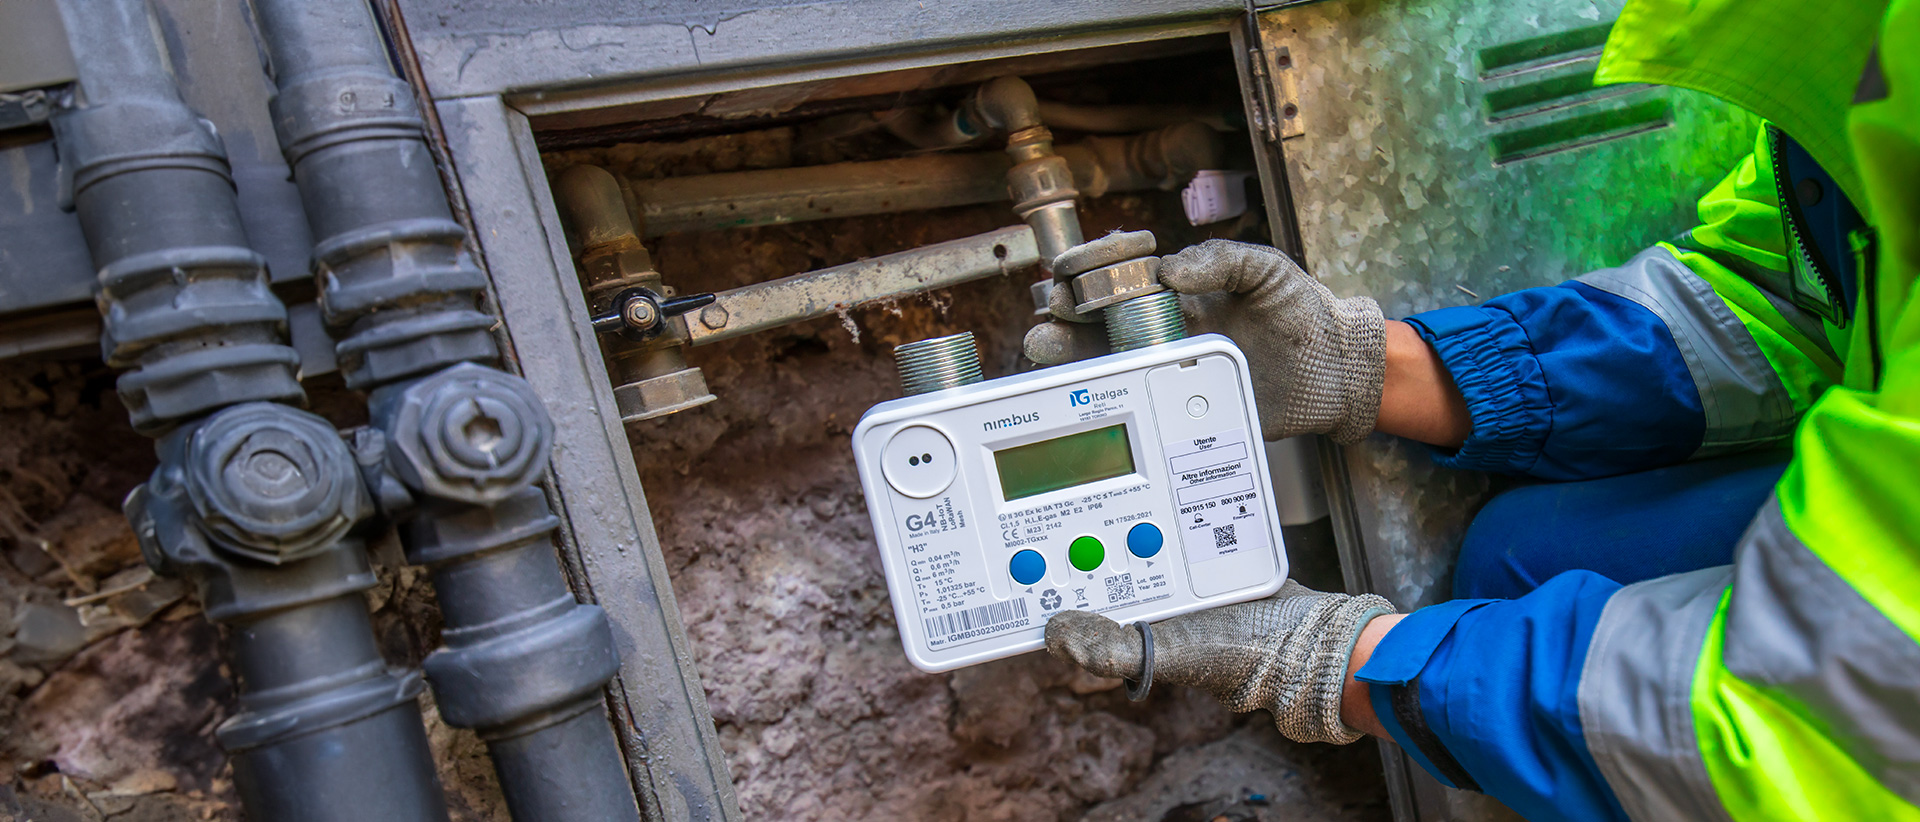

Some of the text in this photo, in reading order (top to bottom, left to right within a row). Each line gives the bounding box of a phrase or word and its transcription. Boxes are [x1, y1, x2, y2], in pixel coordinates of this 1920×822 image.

[1092, 388, 1128, 401] Italgas
[984, 412, 1039, 431] nimbus
[1194, 437, 1216, 446] Utente
[1199, 462, 1241, 477] informazioni
[1245, 492, 1256, 500] 999
[1088, 502, 1103, 510] IP66
[1192, 504, 1204, 512] 915
[1205, 501, 1216, 509] 150
[936, 504, 948, 531] NB-IoT
[944, 497, 957, 530] LoRaWAN
[957, 510, 965, 528] Mesh
[906, 511, 937, 531] G4
[1027, 526, 1041, 534] M23
[1046, 522, 1062, 530] 2142
[908, 543, 927, 553] "H3"
[937, 583, 963, 594] 1,01325
[948, 618, 1030, 642] IGMB030230000202
